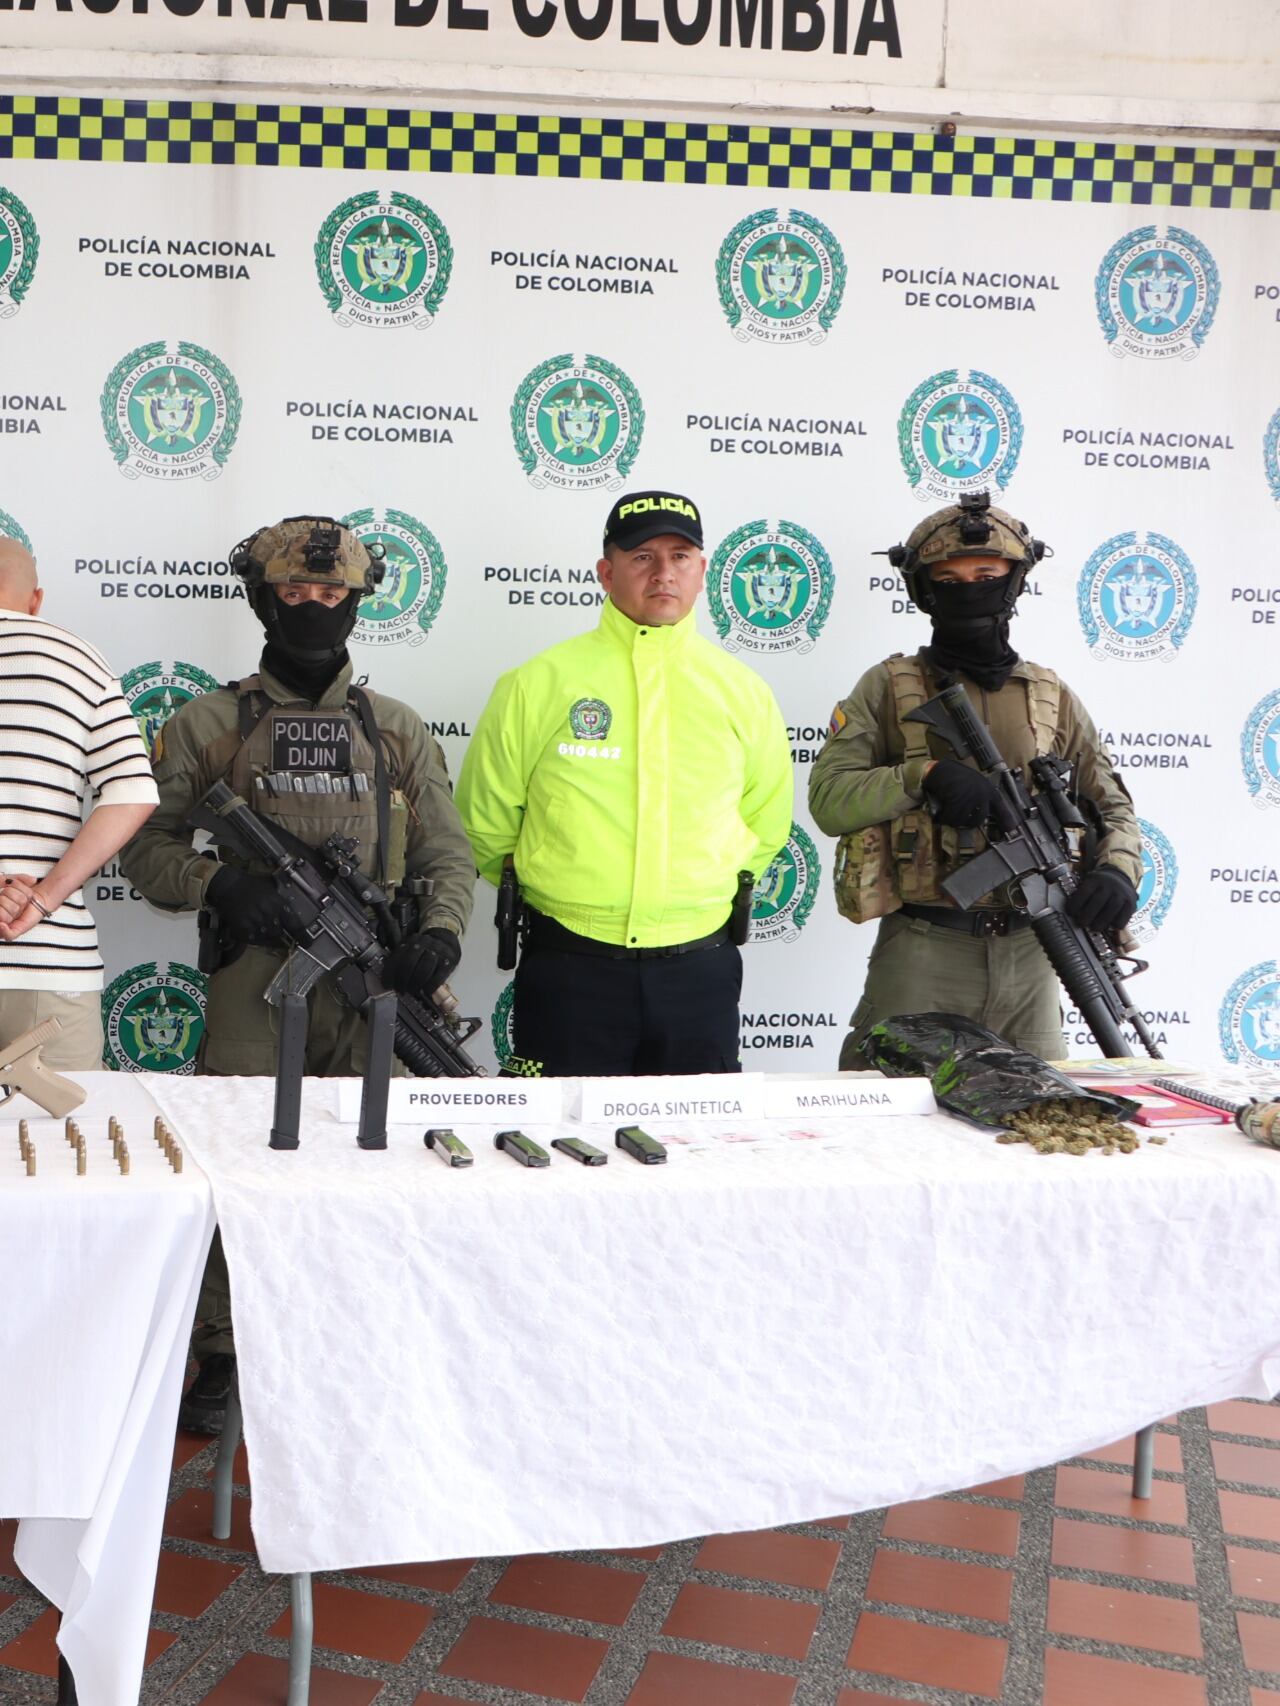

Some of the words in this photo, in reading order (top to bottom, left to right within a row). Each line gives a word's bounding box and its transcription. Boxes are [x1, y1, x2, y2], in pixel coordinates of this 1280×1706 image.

[78, 235, 162, 255] POLICÍA
[167, 240, 276, 258] NACIONAL
[104, 261, 133, 277] DE
[137, 262, 250, 280] COLOMBIA
[490, 249, 570, 269] POLICÍA
[575, 254, 679, 274] NACIONAL
[515, 274, 542, 290] DE
[547, 276, 654, 295] COLOMBIA
[882, 267, 957, 286] POLICÍA
[962, 271, 1060, 291] NACIONAL
[905, 291, 931, 307] DE
[935, 293, 1036, 312] COLOMBIA
[286, 399, 368, 419] POLICÍA
[372, 404, 479, 422] NACIONAL
[598, 376, 628, 432] COLOMBIA
[686, 412, 763, 432] POLICÍA
[768, 417, 868, 436] NACIONAL
[311, 425, 339, 441] DE
[344, 426, 454, 444] COLOMBIA
[1062, 427, 1135, 446] POLICÍA
[1139, 432, 1235, 450] NACIONAL
[710, 438, 736, 454] DE
[740, 439, 844, 457] COLOMBIA
[577, 443, 623, 474] NACIONAL
[1084, 451, 1109, 467] DE
[1113, 452, 1211, 471] COLOMBIA
[543, 470, 566, 486] DIOS
[577, 473, 612, 487] PATRIA
[74, 556, 158, 575] POLICÍA
[163, 560, 236, 577] NACIO
[484, 564, 563, 583] POLICÍA
[790, 541, 819, 596] COLOMBIA
[100, 582, 129, 598] DE
[134, 583, 246, 600] COLOMBIA
[508, 590, 535, 605] DE
[540, 591, 608, 607] COLO
[1231, 587, 1280, 603] POLIC
[891, 600, 916, 614] DE
[769, 606, 814, 638] NACIONAL
[1252, 610, 1276, 624] DE
[736, 634, 760, 649] DIOS
[768, 636, 802, 651] PATRIA
[274, 722, 350, 743] POLICIA
[786, 726, 830, 742] CION
[1120, 732, 1213, 748] NACIONAL
[288, 747, 337, 766] DIJIN
[1110, 754, 1190, 769] OLOMBIA
[1210, 865, 1279, 882] POLICÍA
[96, 886, 125, 901] DE
[1230, 889, 1254, 903] DE
[741, 1013, 838, 1028] NACIONAL
[741, 1034, 814, 1049] LOMBIA
[409, 1093, 528, 1106] PROVEEDORES
[603, 1102, 661, 1117] DROGA
[665, 1100, 743, 1116] SINTETICA
[796, 1093, 892, 1107] MARIHUANA
